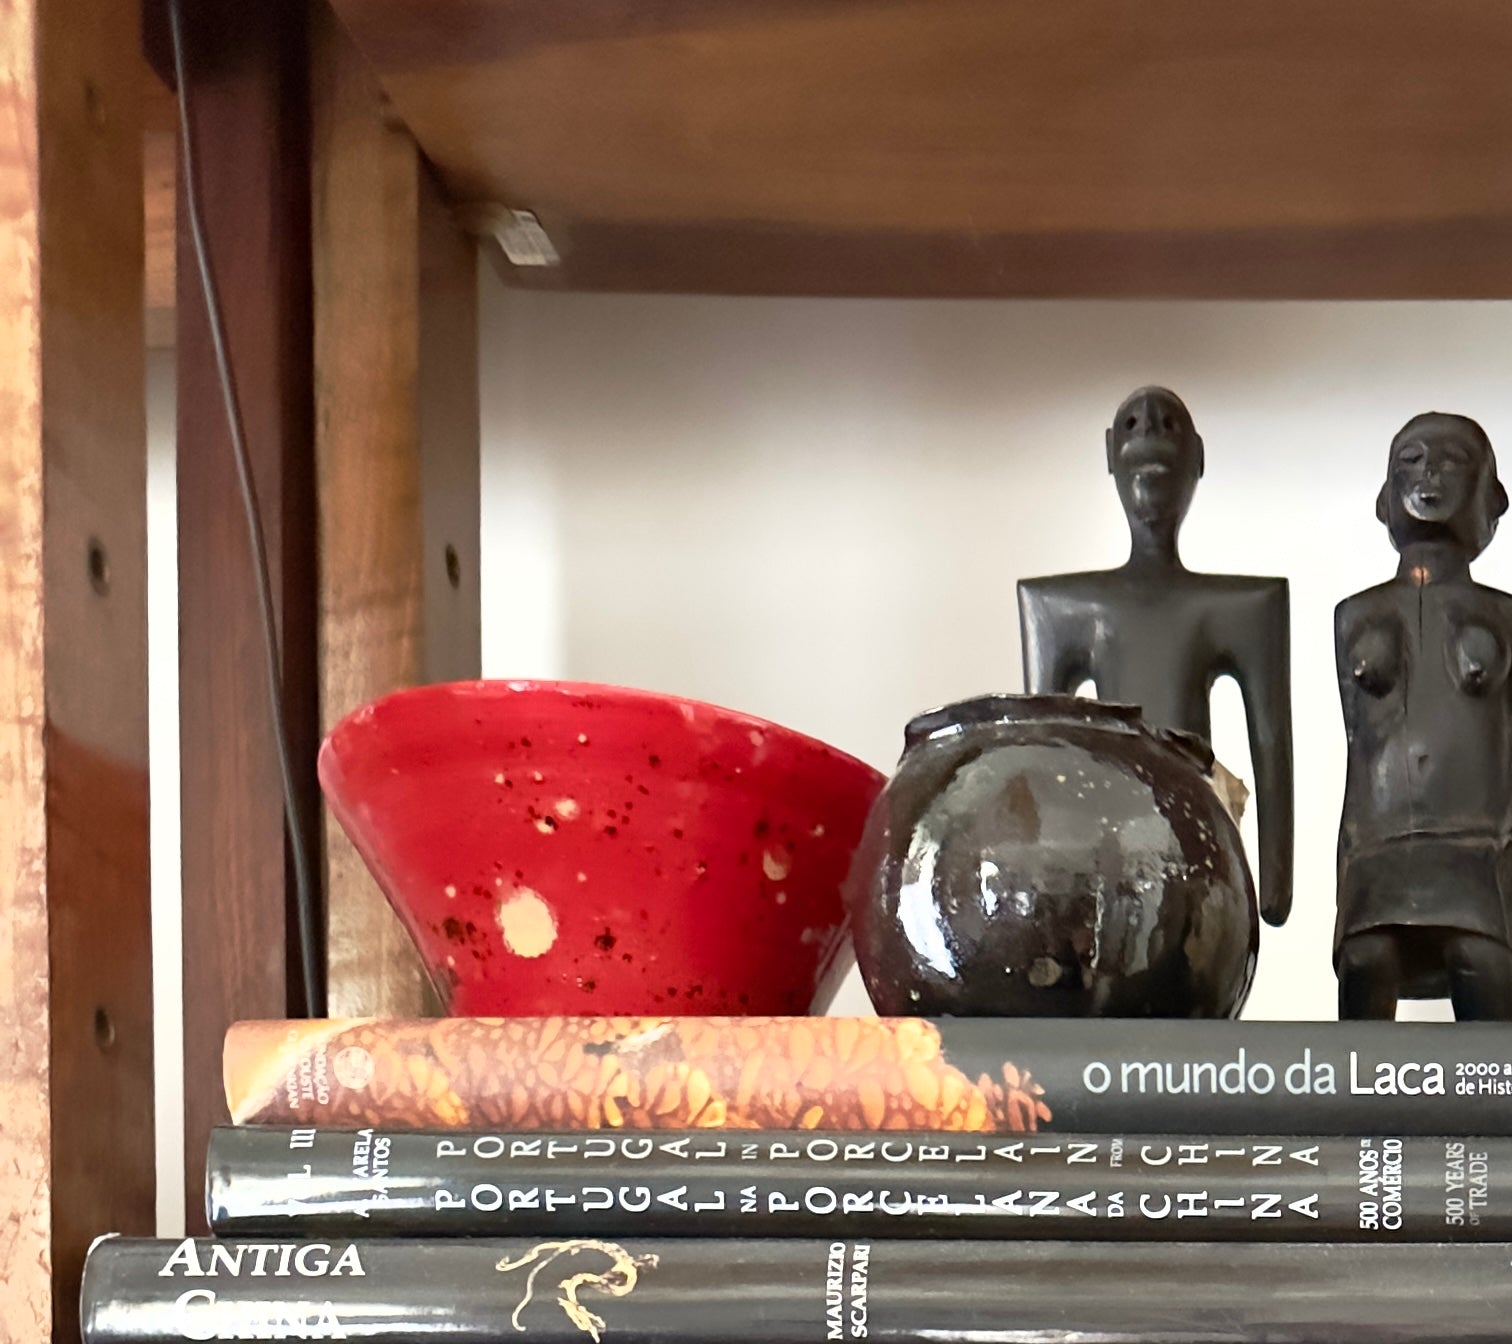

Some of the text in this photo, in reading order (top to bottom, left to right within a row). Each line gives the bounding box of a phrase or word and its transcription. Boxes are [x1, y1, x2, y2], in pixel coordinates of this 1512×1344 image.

[1083, 1047, 1446, 1096] o mundo da Laca
[1455, 1062, 1500, 1077] 2000
[1455, 1077, 1476, 1096] de
[436, 1135, 727, 1161] PORTUGAL
[740, 1143, 759, 1161] IN
[769, 1138, 1099, 1165] PORCELAIN
[1140, 1143, 1320, 1167] CHINA
[1358, 1149, 1379, 1197] ANOS
[434, 1183, 1320, 1220] PORTUGAL NA PORCELANA DA CHINA
[1379, 1138, 1403, 1231] COMÉRCIO
[1445, 1142, 1465, 1227] 500 YEARS
[1468, 1151, 1488, 1211] TRADE
[1359, 1201, 1379, 1230] 500
[158, 1237, 366, 1277] ANTIGA
[826, 1241, 846, 1340] MAURIZIO
[850, 1244, 871, 1338] SCARPARI
